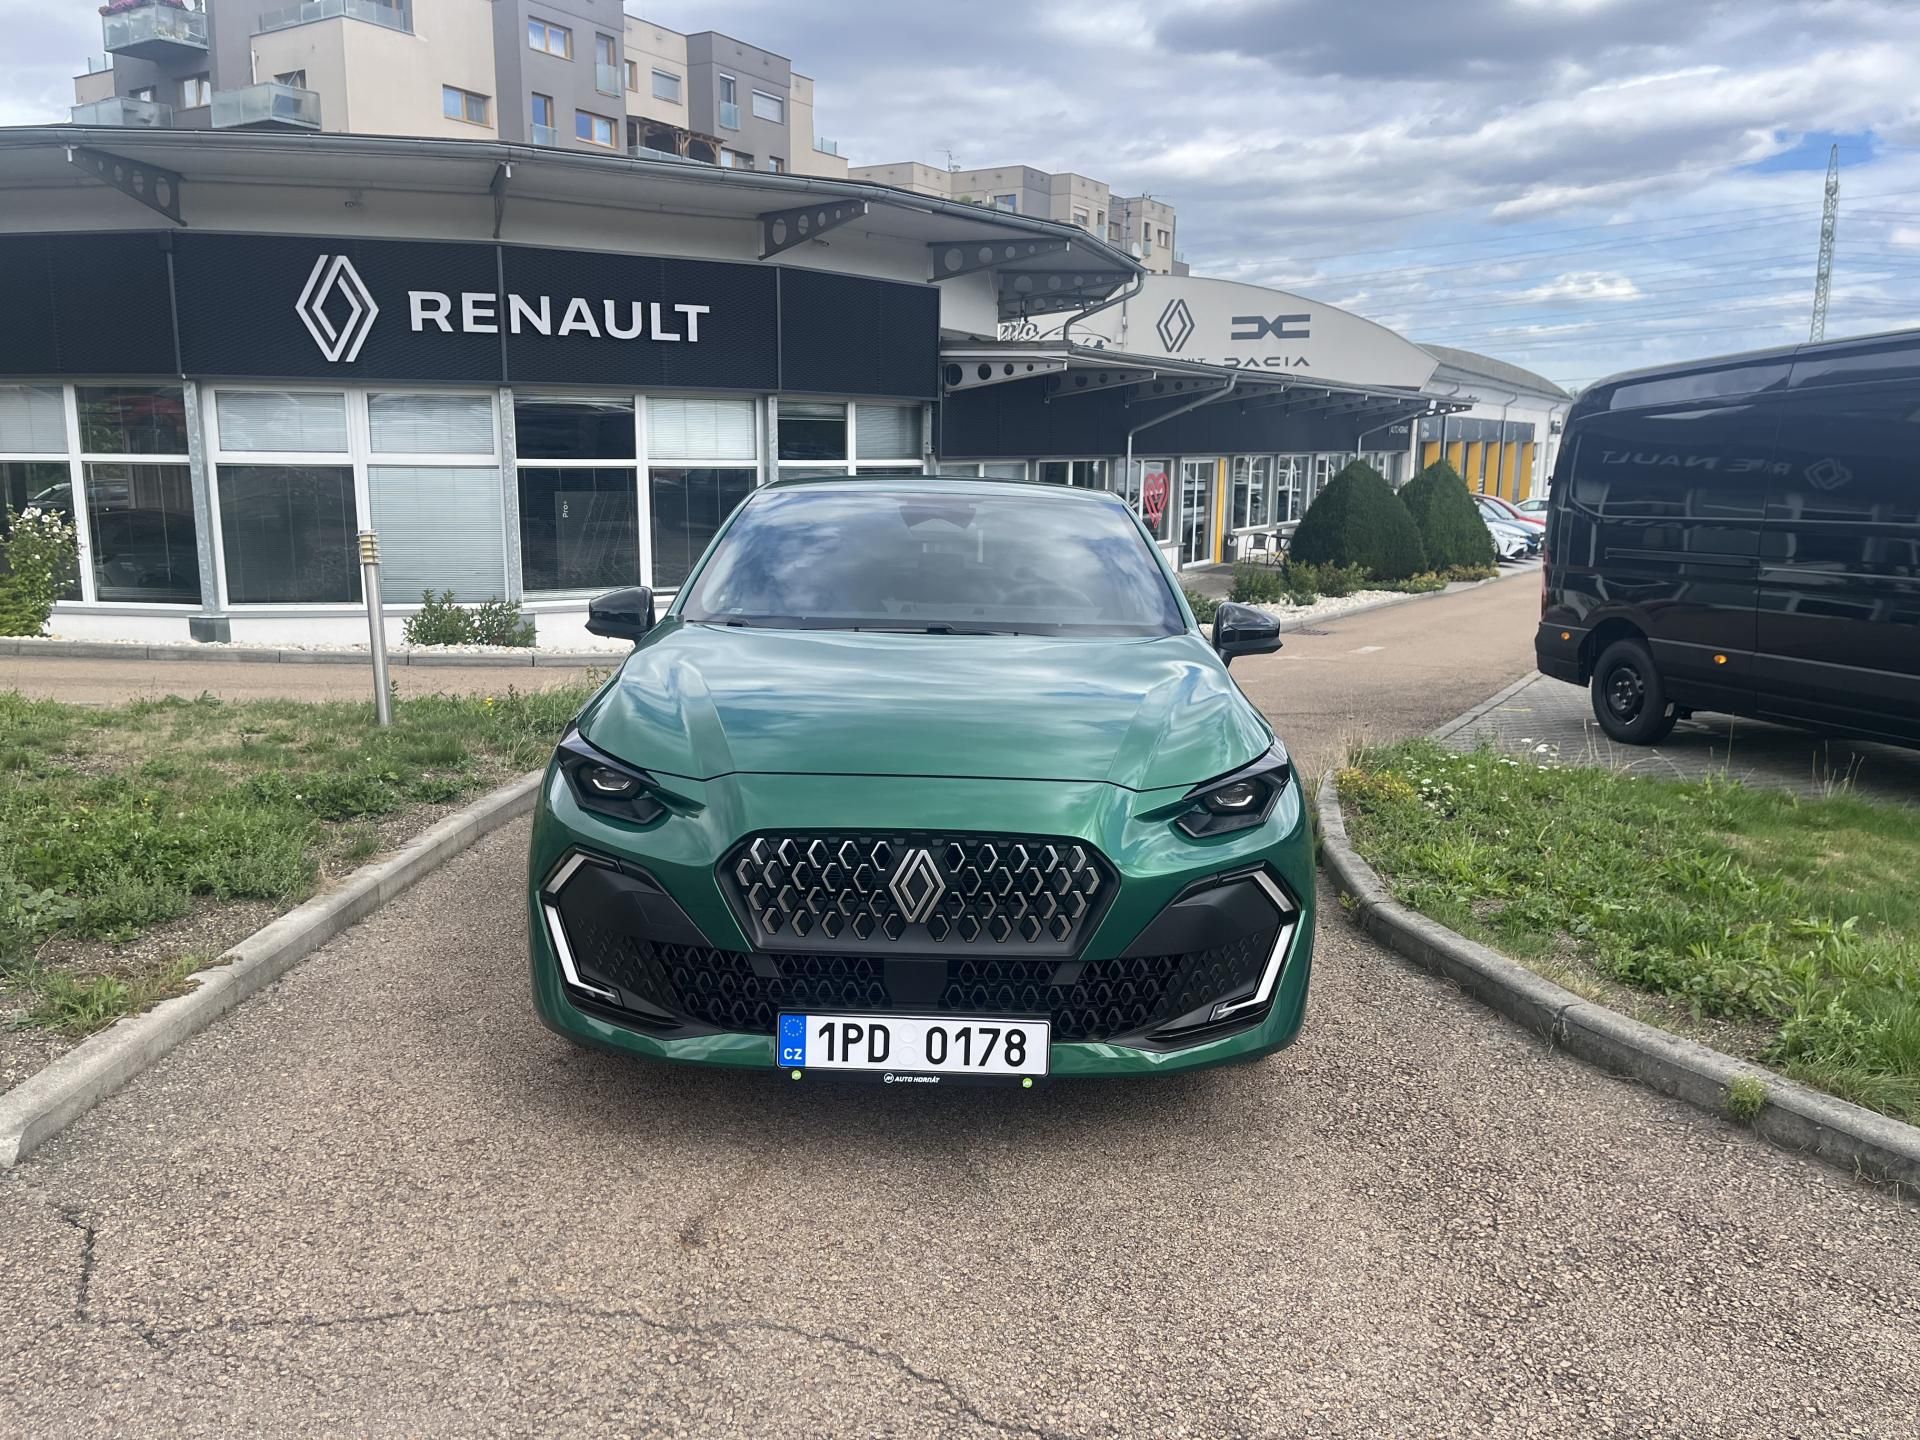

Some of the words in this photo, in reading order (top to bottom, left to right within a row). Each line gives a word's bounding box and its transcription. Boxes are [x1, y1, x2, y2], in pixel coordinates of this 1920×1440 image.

[408, 290, 710, 342] RENAULT
[1224, 356, 1310, 368] DACIA
[783, 1047, 803, 1061] CZ
[818, 1022, 890, 1063] 1PD
[925, 1026, 1027, 1067] 0178
